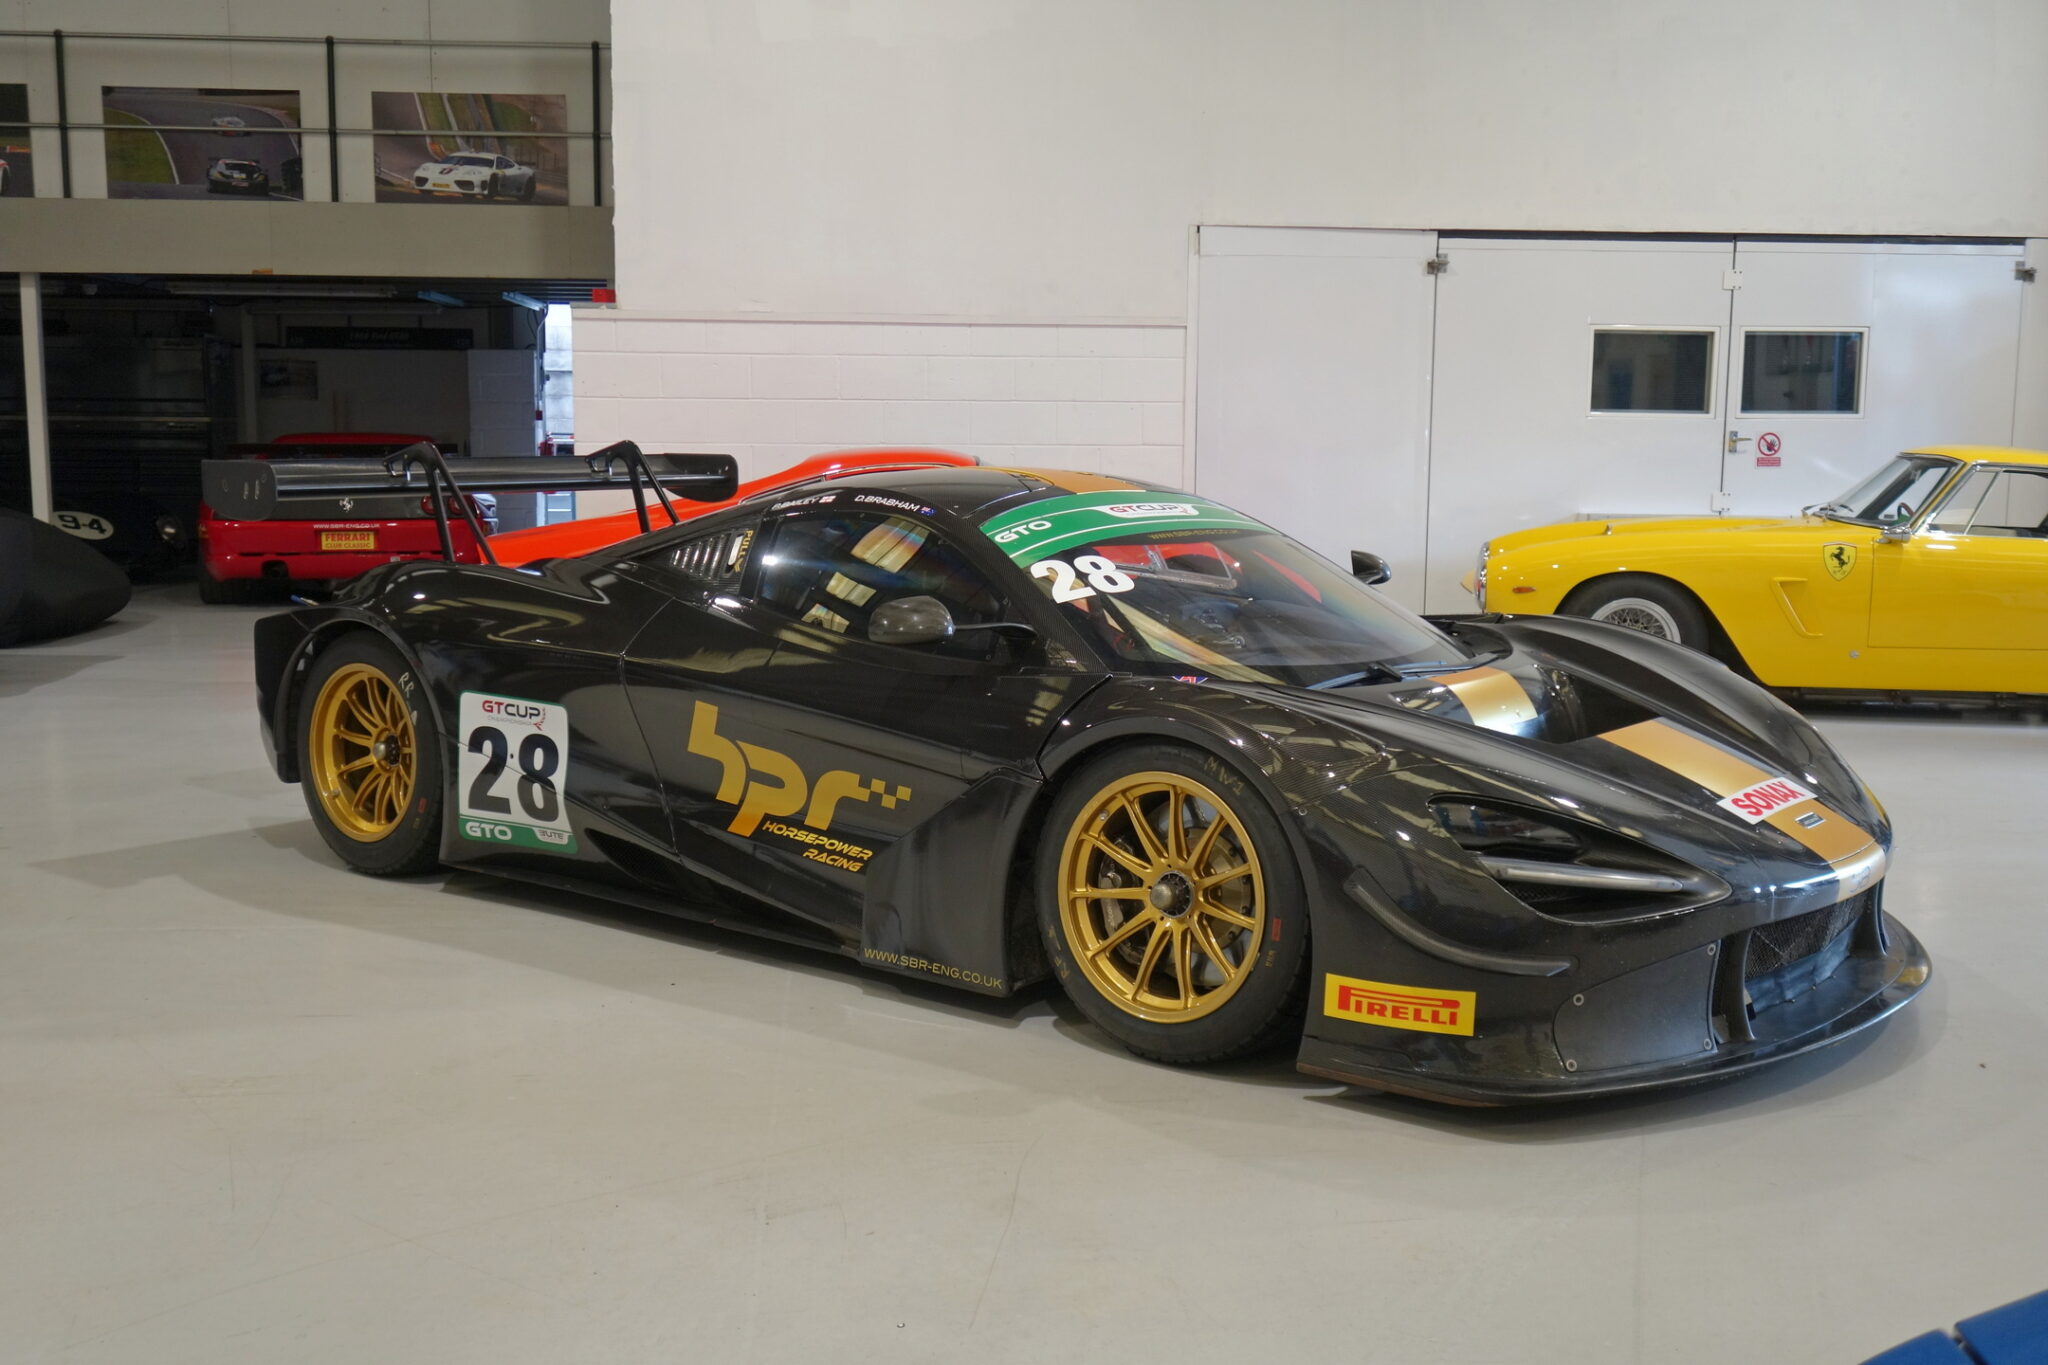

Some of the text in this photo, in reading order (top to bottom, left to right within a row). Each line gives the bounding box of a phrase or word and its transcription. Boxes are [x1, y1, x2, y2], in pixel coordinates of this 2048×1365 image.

[854, 494, 920, 512] D.BRABHAM
[325, 533, 370, 541] FERRARI
[738, 530, 754, 558] PULL
[994, 520, 1052, 543] GTO
[1030, 555, 1135, 604] 28
[467, 725, 560, 823] 28
[1731, 781, 1805, 817] SONAX
[465, 821, 513, 841] GTO
[762, 820, 874, 861] HORSEPOWER
[803, 848, 864, 873] RACING
[863, 947, 1003, 989] WWW.SBR-ENG.CO.UK
[1337, 984, 1460, 1026] PIRELLI
